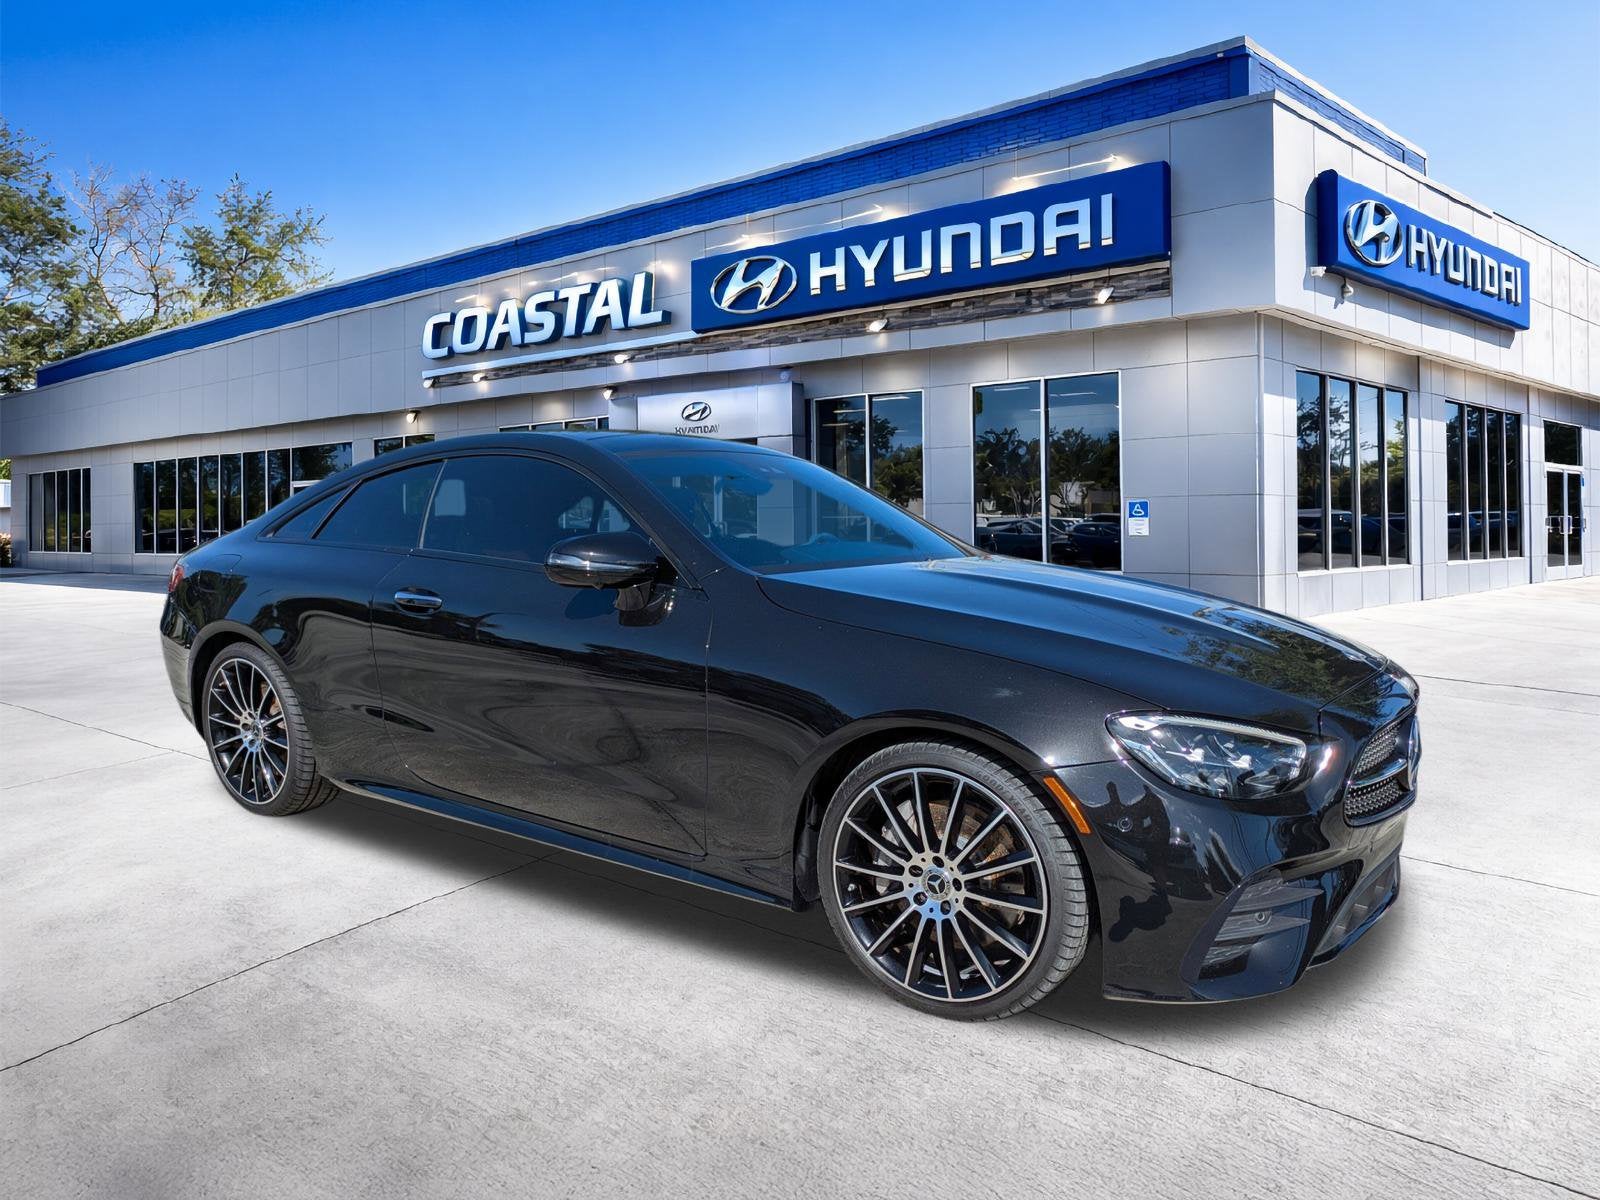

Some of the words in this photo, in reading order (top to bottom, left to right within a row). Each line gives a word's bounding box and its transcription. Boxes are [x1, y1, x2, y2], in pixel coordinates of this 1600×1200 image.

[809, 193, 1114, 295] HYUNDAI
[1407, 224, 1521, 306] HYUNDAI
[422, 271, 669, 359] COASTAL
